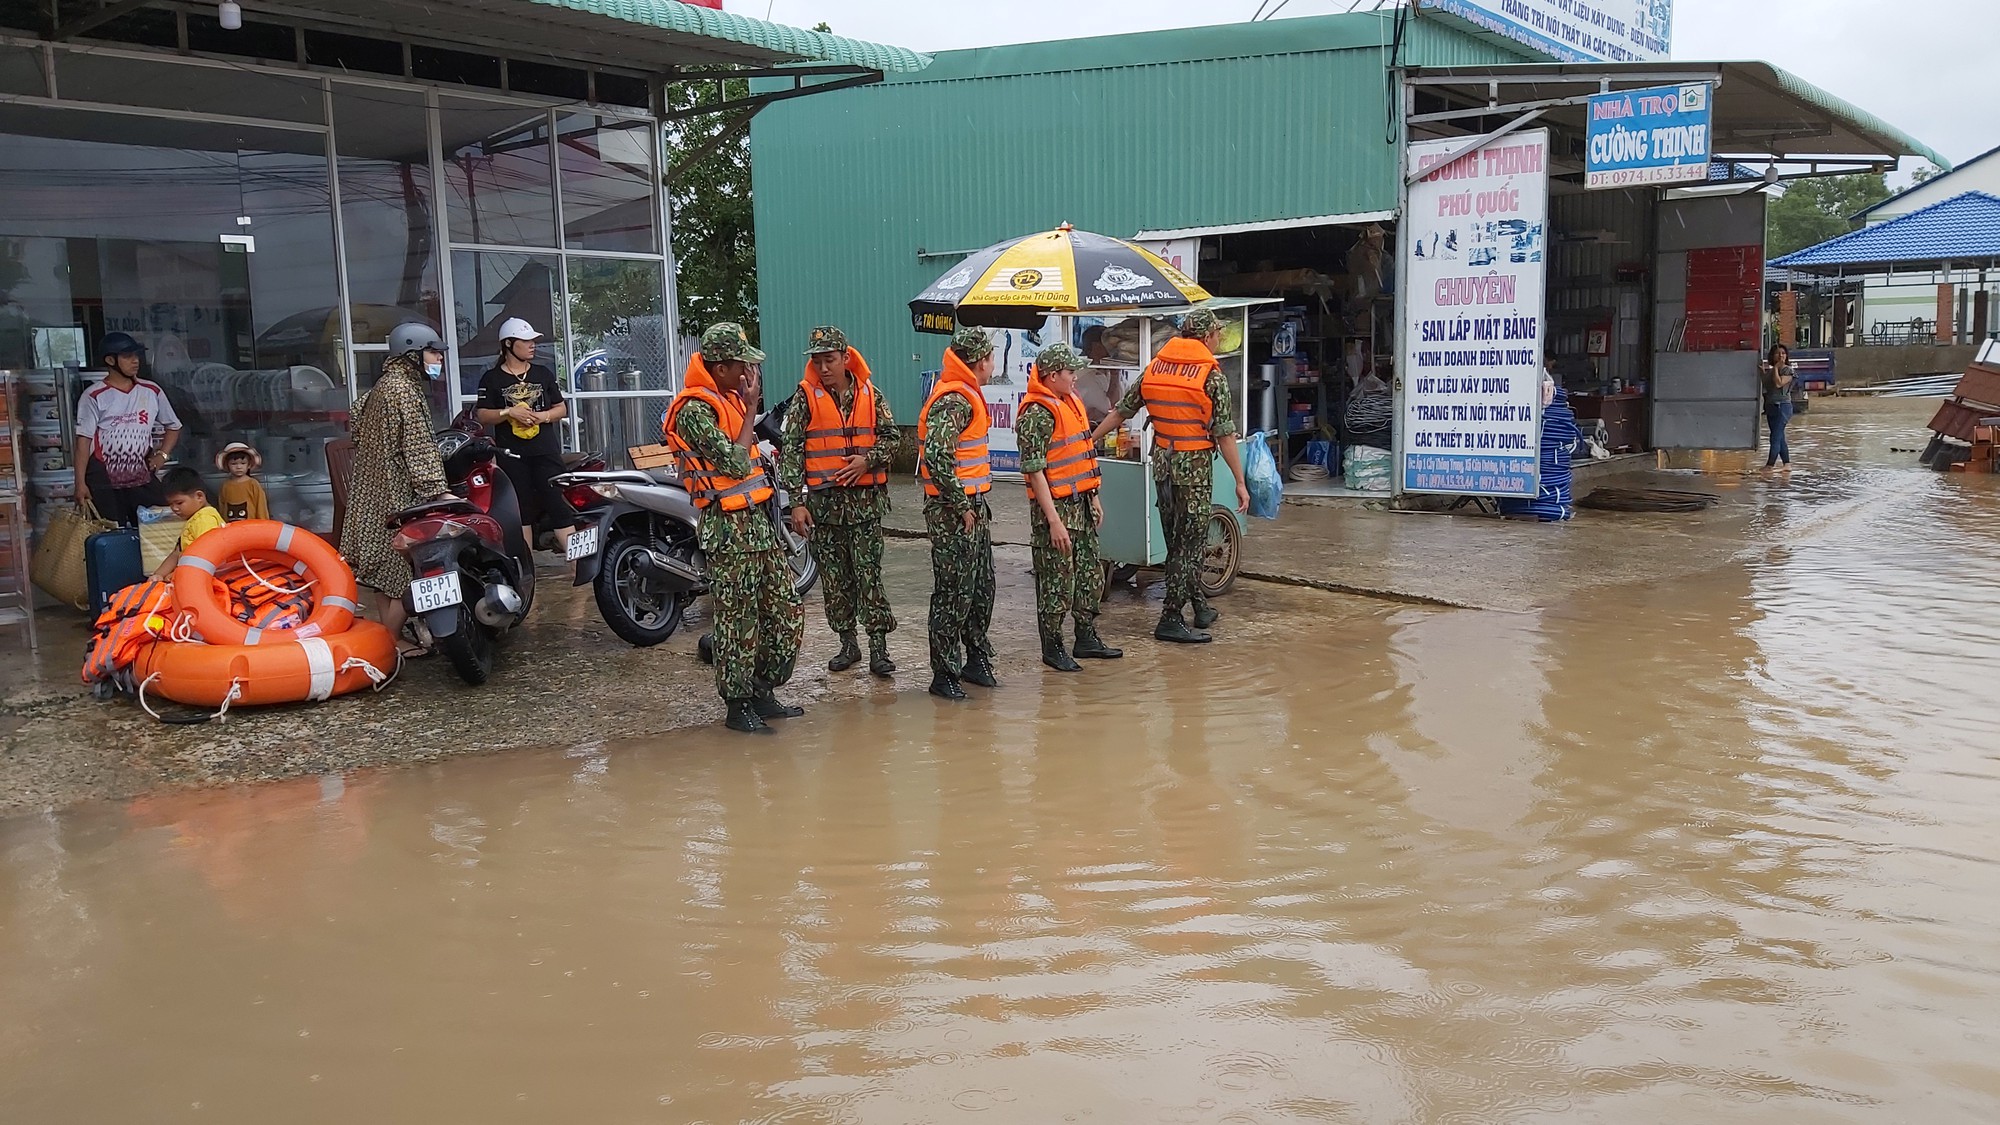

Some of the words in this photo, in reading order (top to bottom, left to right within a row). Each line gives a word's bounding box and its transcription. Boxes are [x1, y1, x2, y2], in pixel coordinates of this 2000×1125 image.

[1500, 0, 1530, 22] TRANG
[1531, 8, 1546, 30] TRÍ
[1546, 15, 1560, 38] NỘI
[1561, 23, 1581, 45] THẤT
[1581, 31, 1592, 50] VÀ
[1593, 36, 1606, 56] CÁC
[1607, 42, 1627, 62] THIẾT
[1573, 1, 1590, 23] LIỆU
[1591, 8, 1606, 29] XÂY
[1606, 15, 1625, 37] DỰNG
[1630, 27, 1646, 48] ĐIỆN
[1593, 94, 1634, 121] NHÀ
[1638, 93, 1678, 118] TRỌ
[1590, 123, 1648, 164] CƯỜNG
[1651, 124, 1707, 167] THỊNH
[1483, 143, 1544, 180] THỊNH
[1590, 173, 1609, 186] ĐT:
[1612, 165, 1704, 185] 0974.15.33.44
[1438, 188, 1472, 218] PHÚ
[1475, 181, 1520, 219] QUỐC
[1033, 291, 1046, 301] Trí
[1046, 291, 1070, 303] Dũng
[1434, 270, 1517, 307] CHUYÊN
[1422, 319, 1446, 342] SAN
[1450, 311, 1471, 342] LẤP
[1474, 313, 1501, 345] MẶT
[1503, 308, 1537, 341] BẰNG
[1418, 350, 1442, 367] KINH
[1444, 350, 1478, 367] DOANH
[1479, 346, 1504, 369] ĐIỆN
[1505, 346, 1536, 369] NƯỚC,
[1416, 375, 1435, 397] VẬT
[1437, 375, 1458, 397] LIỆU
[1460, 375, 1480, 394] XÂY
[1481, 377, 1510, 397] DỰNG
[1417, 405, 1449, 421] TRANG
[1452, 402, 1468, 421] TRÍ
[1469, 402, 1487, 424] NỘI
[1489, 400, 1516, 422] THẤT
[1518, 402, 1532, 422] VÀ
[1415, 429, 1432, 448] CÁC
[1434, 427, 1462, 448] THIẾT
[1464, 432, 1475, 451] BỊ
[1476, 430, 1496, 449] XÂY
[418, 588, 459, 610] 150.41
